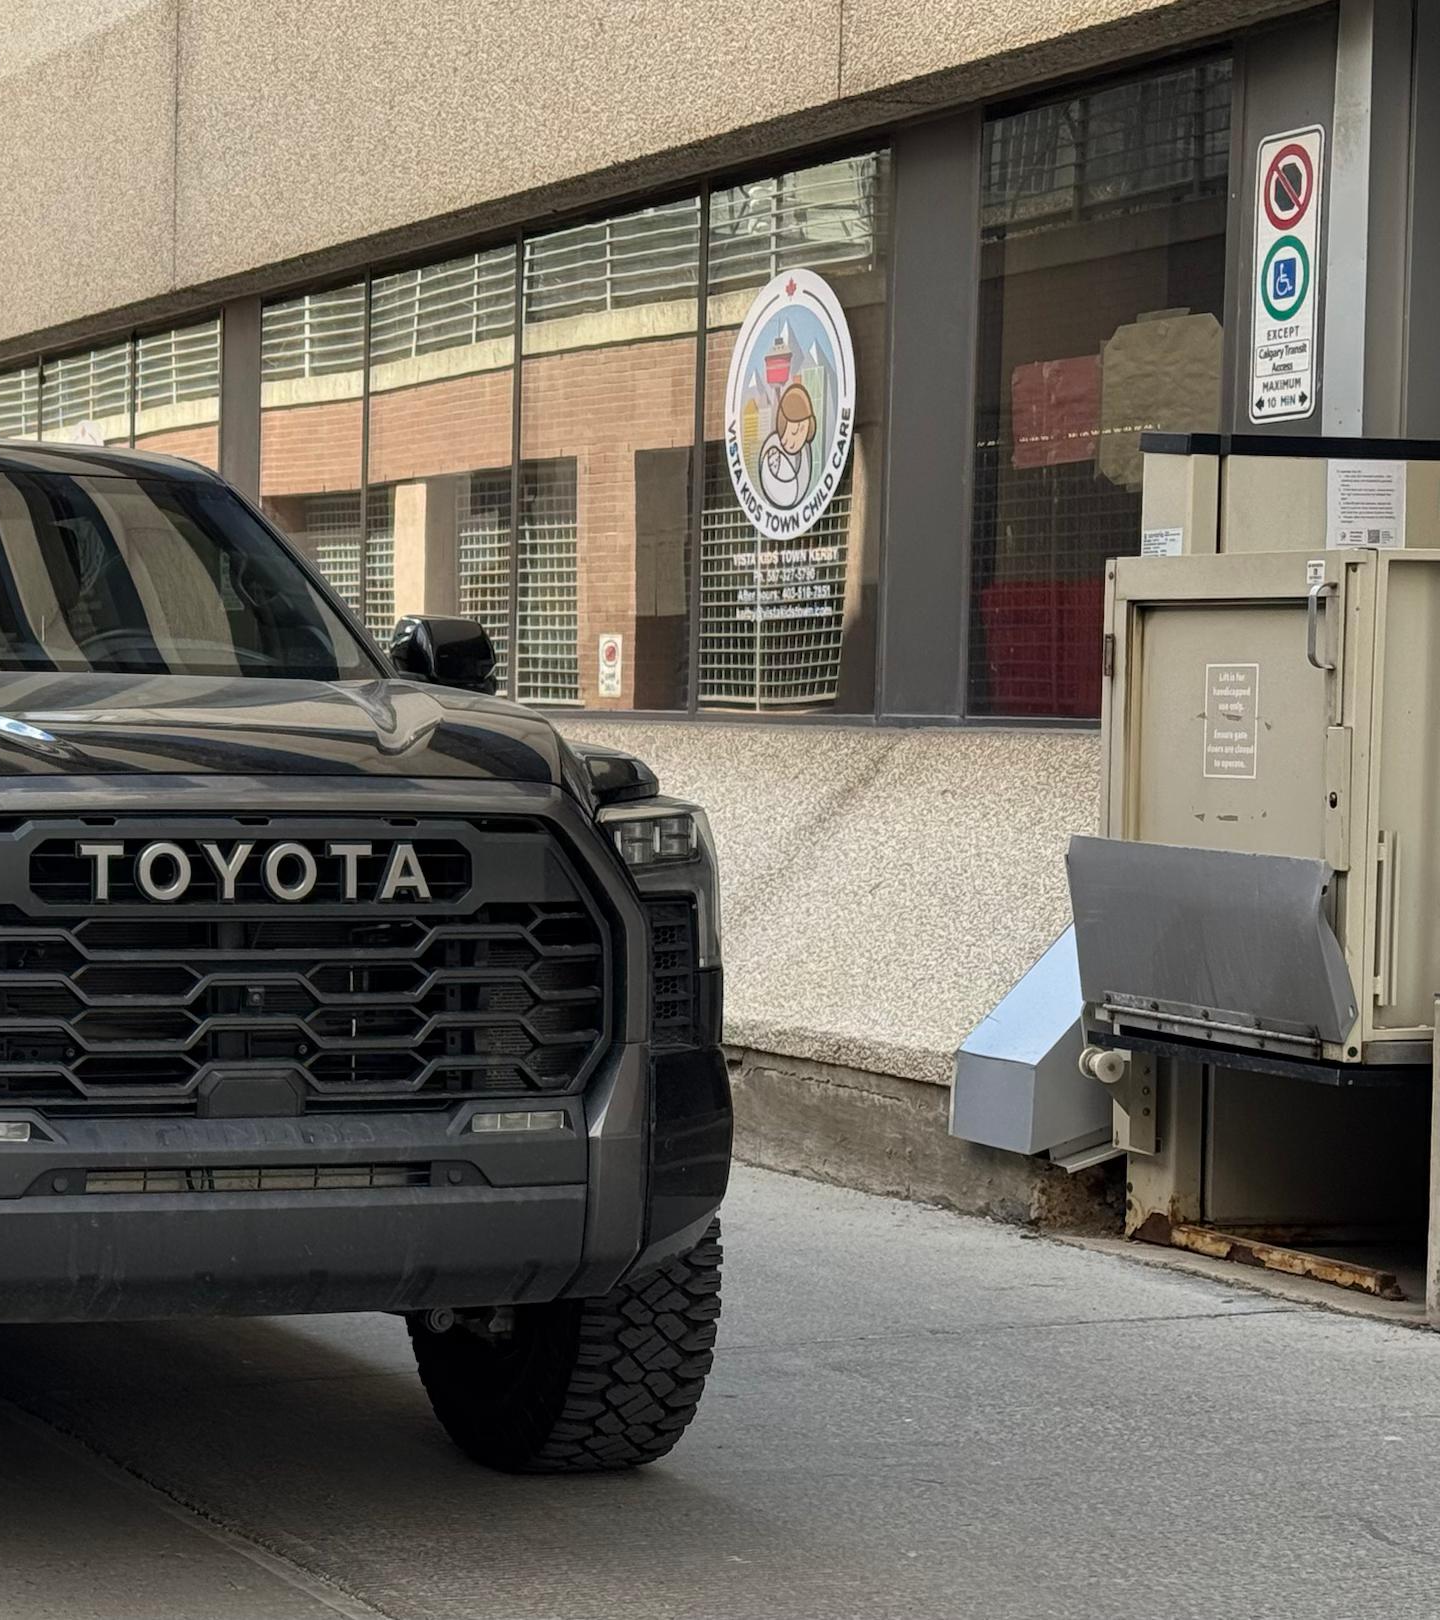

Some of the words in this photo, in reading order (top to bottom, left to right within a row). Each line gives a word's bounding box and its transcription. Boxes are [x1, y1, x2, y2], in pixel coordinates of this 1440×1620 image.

[1267, 325, 1300, 341] EXCEPT
[1258, 348, 1284, 361] Calgary
[1284, 343, 1308, 356] Transit
[1272, 362, 1294, 373] Access
[1262, 377, 1302, 394] MAXIMUM
[1267, 397, 1277, 408] 10
[1280, 394, 1296, 407] MIN
[728, 420, 743, 485] VISTA
[740, 482, 763, 523] KIDS
[765, 511, 801, 533] TOWN
[802, 473, 834, 523] CHILD
[832, 407, 852, 470] CARE
[733, 553, 756, 566] VISTA
[758, 551, 779, 565] KIDS
[780, 549, 807, 564] TOWN
[809, 547, 839, 561] KERBY
[76, 840, 432, 903] TOYOTA
